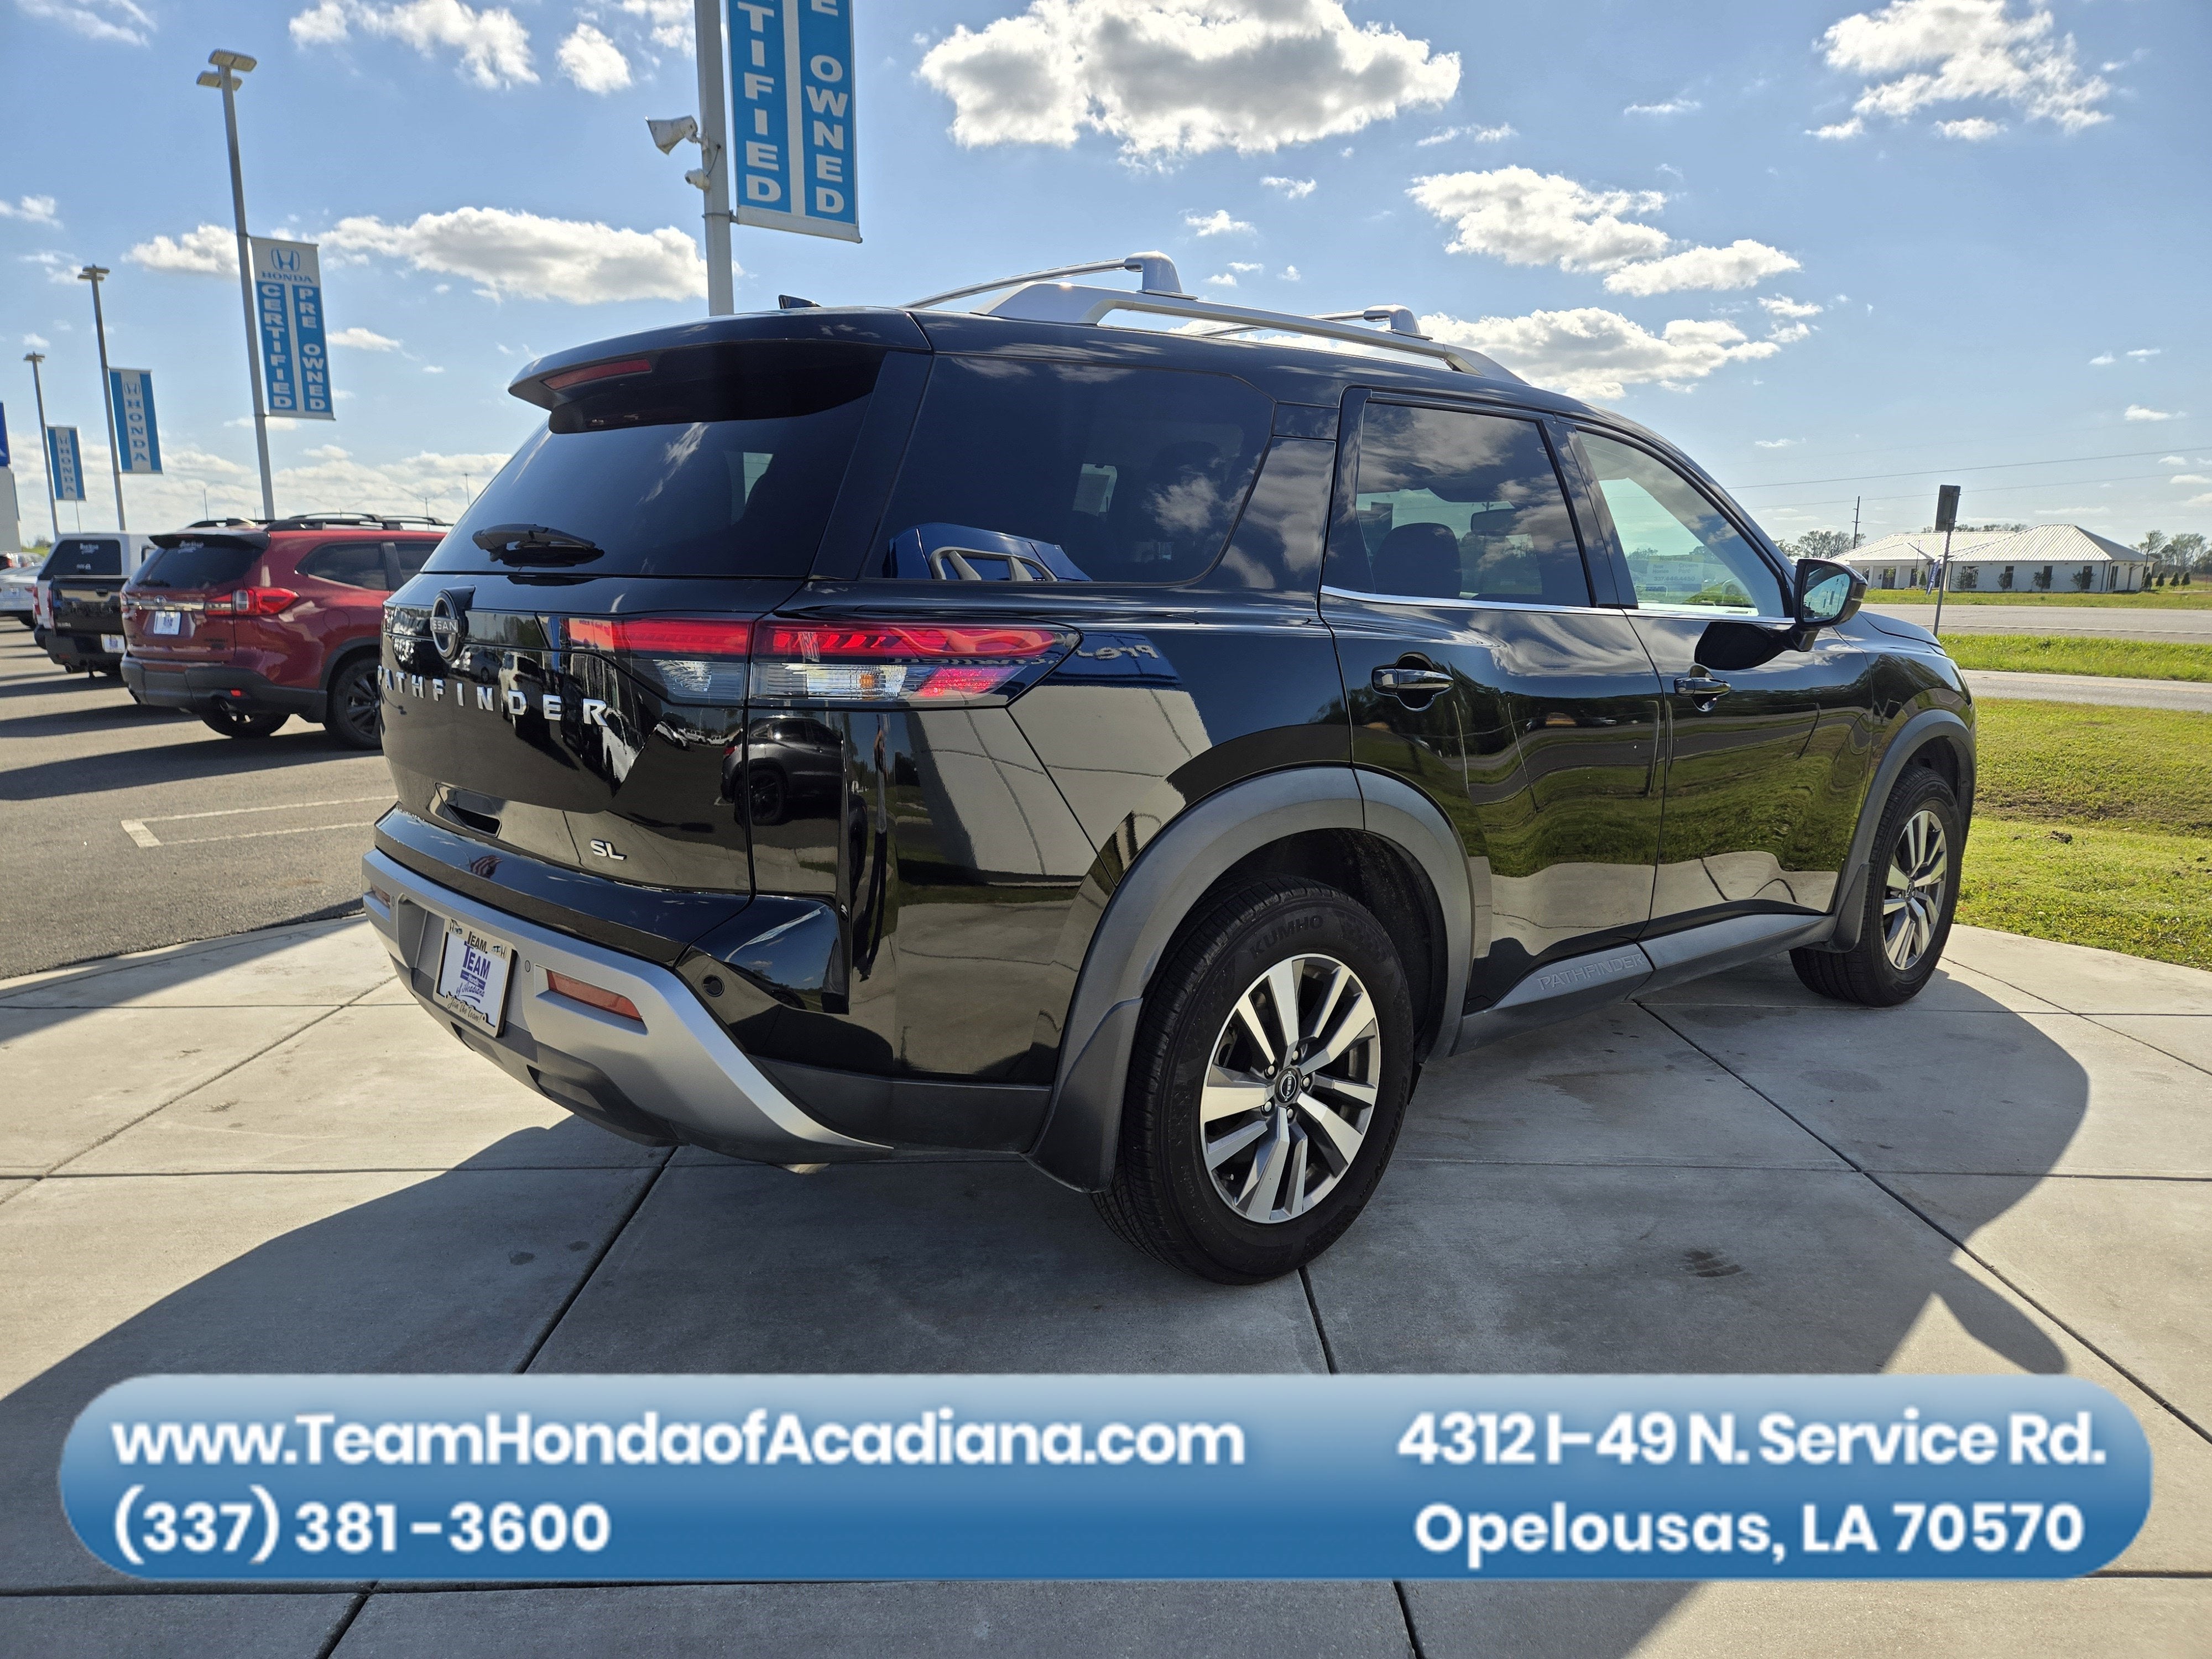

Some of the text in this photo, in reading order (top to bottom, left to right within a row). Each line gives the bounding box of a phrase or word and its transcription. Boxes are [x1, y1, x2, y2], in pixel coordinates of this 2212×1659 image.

[806, 55, 848, 213] OWNED
[261, 270, 312, 283] HONDA
[261, 284, 292, 408] CERTIFIED
[298, 288, 325, 410] PRE OWNED
[126, 399, 148, 461] HONDA
[60, 447, 75, 492] HONDA
[377, 665, 608, 727] PATHFINDER
[590, 839, 628, 860] SL
[462, 940, 491, 980] TEAM
[1249, 915, 1323, 960] KUMHO
[1537, 953, 1645, 990] PATHFINDER
